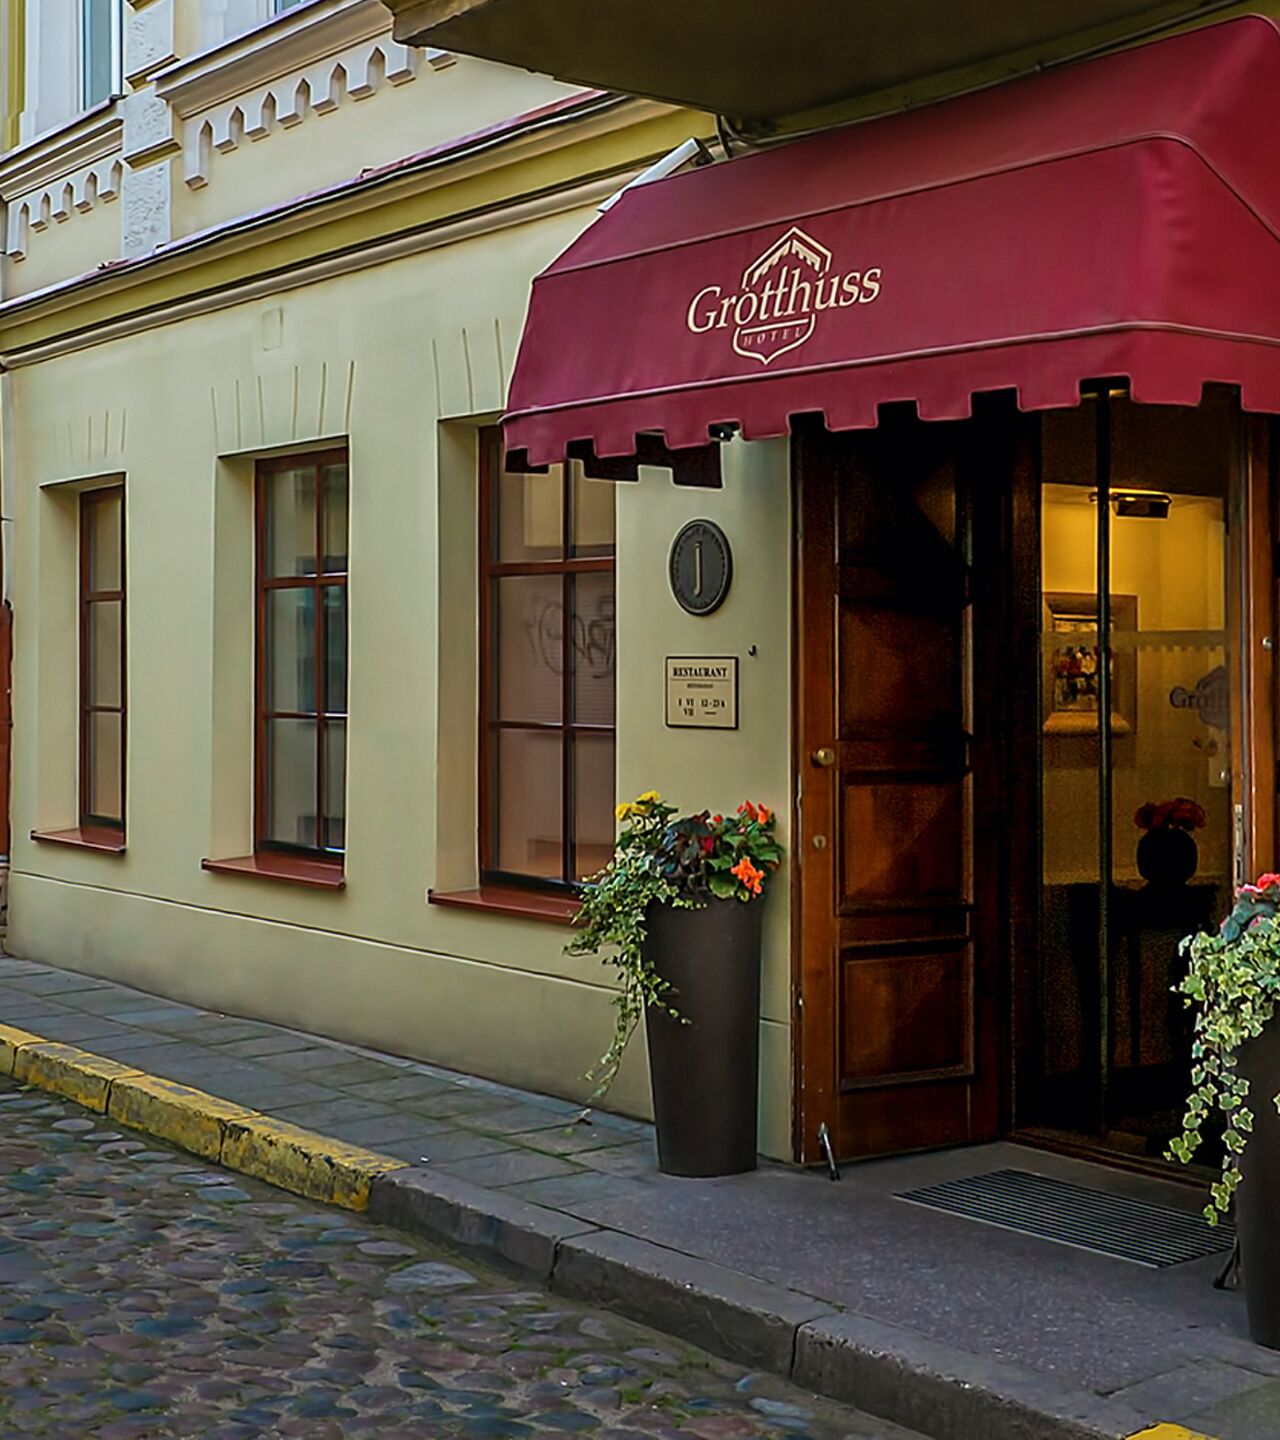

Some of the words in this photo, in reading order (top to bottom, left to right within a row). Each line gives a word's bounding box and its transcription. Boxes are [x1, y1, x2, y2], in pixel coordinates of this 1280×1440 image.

[686, 265, 882, 334] Grotthuss
[742, 326, 802, 347] HOTEL
[672, 666, 728, 678] RESTAURANT
